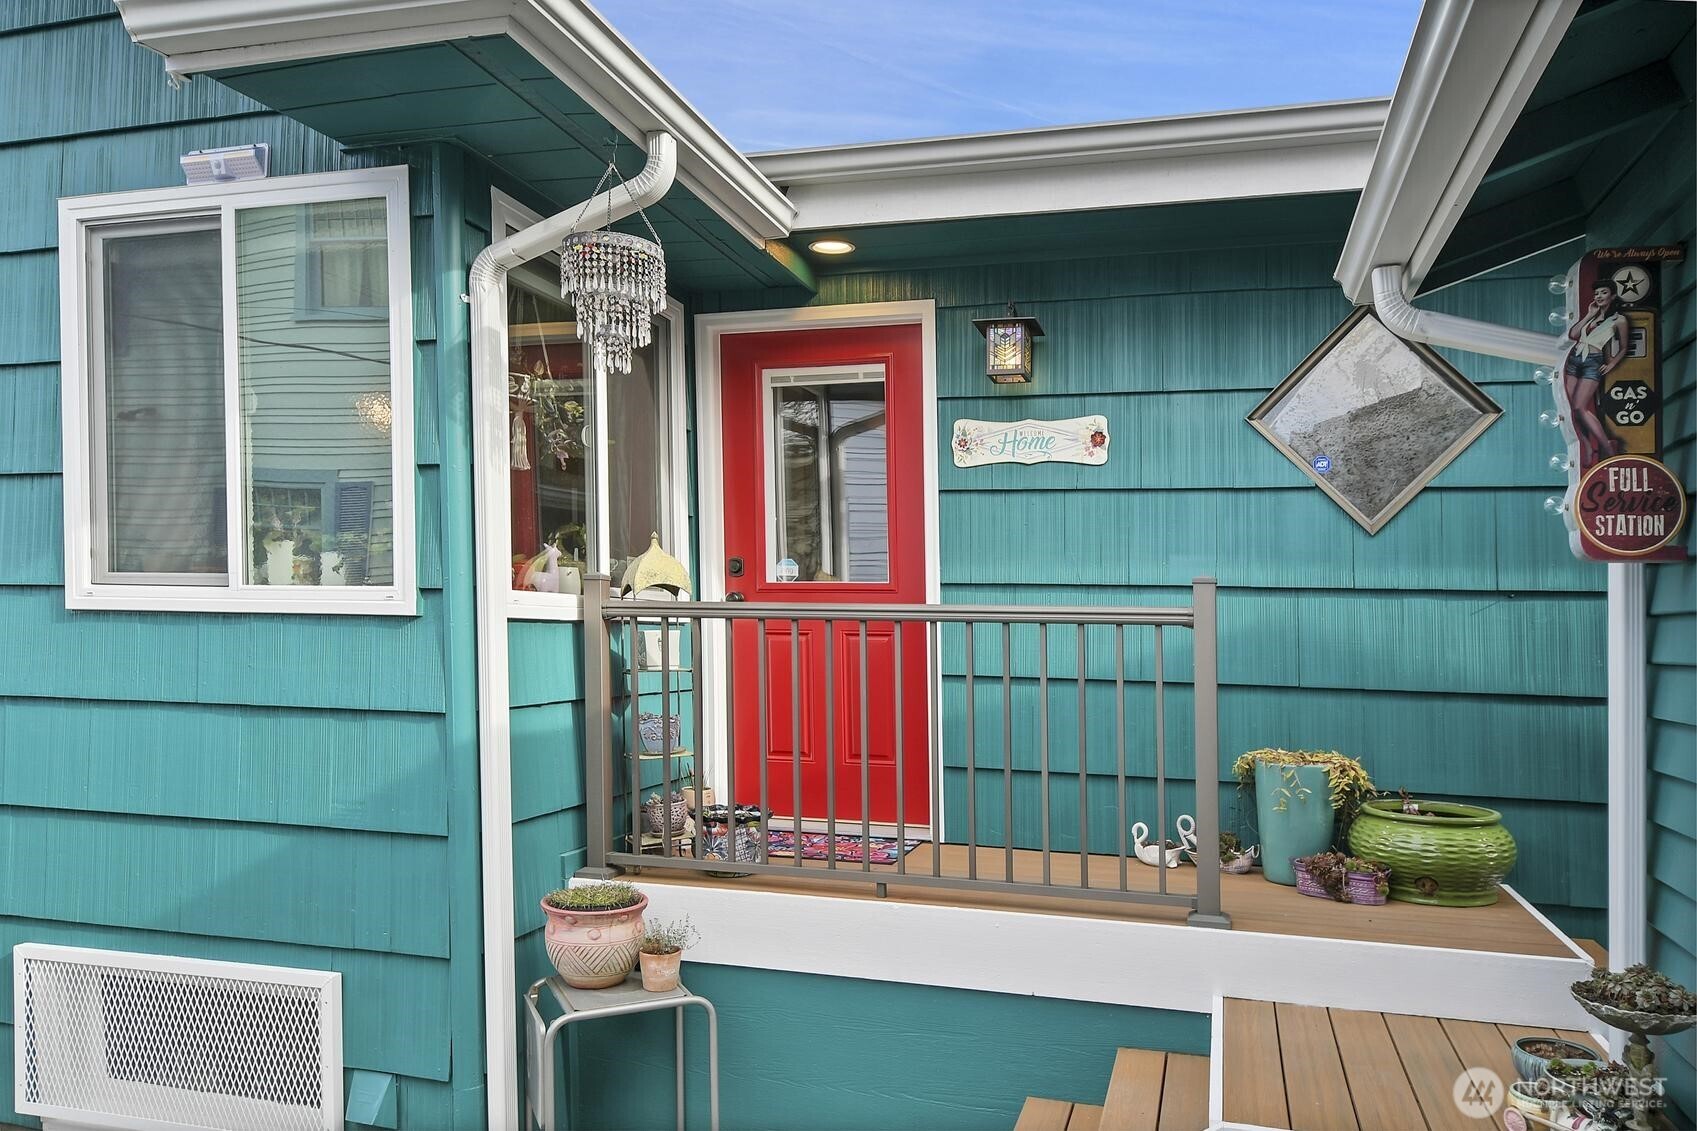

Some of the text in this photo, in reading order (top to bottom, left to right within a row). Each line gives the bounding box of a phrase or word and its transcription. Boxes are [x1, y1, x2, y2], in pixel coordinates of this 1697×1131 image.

[1623, 247, 1655, 261] Always
[1657, 247, 1680, 259] Open
[1610, 386, 1648, 400] GAS
[1615, 410, 1645, 424] GO
[989, 429, 1057, 459] Home
[1608, 467, 1653, 492] FULL
[1581, 481, 1679, 513] Service
[1595, 514, 1665, 537] STATION
